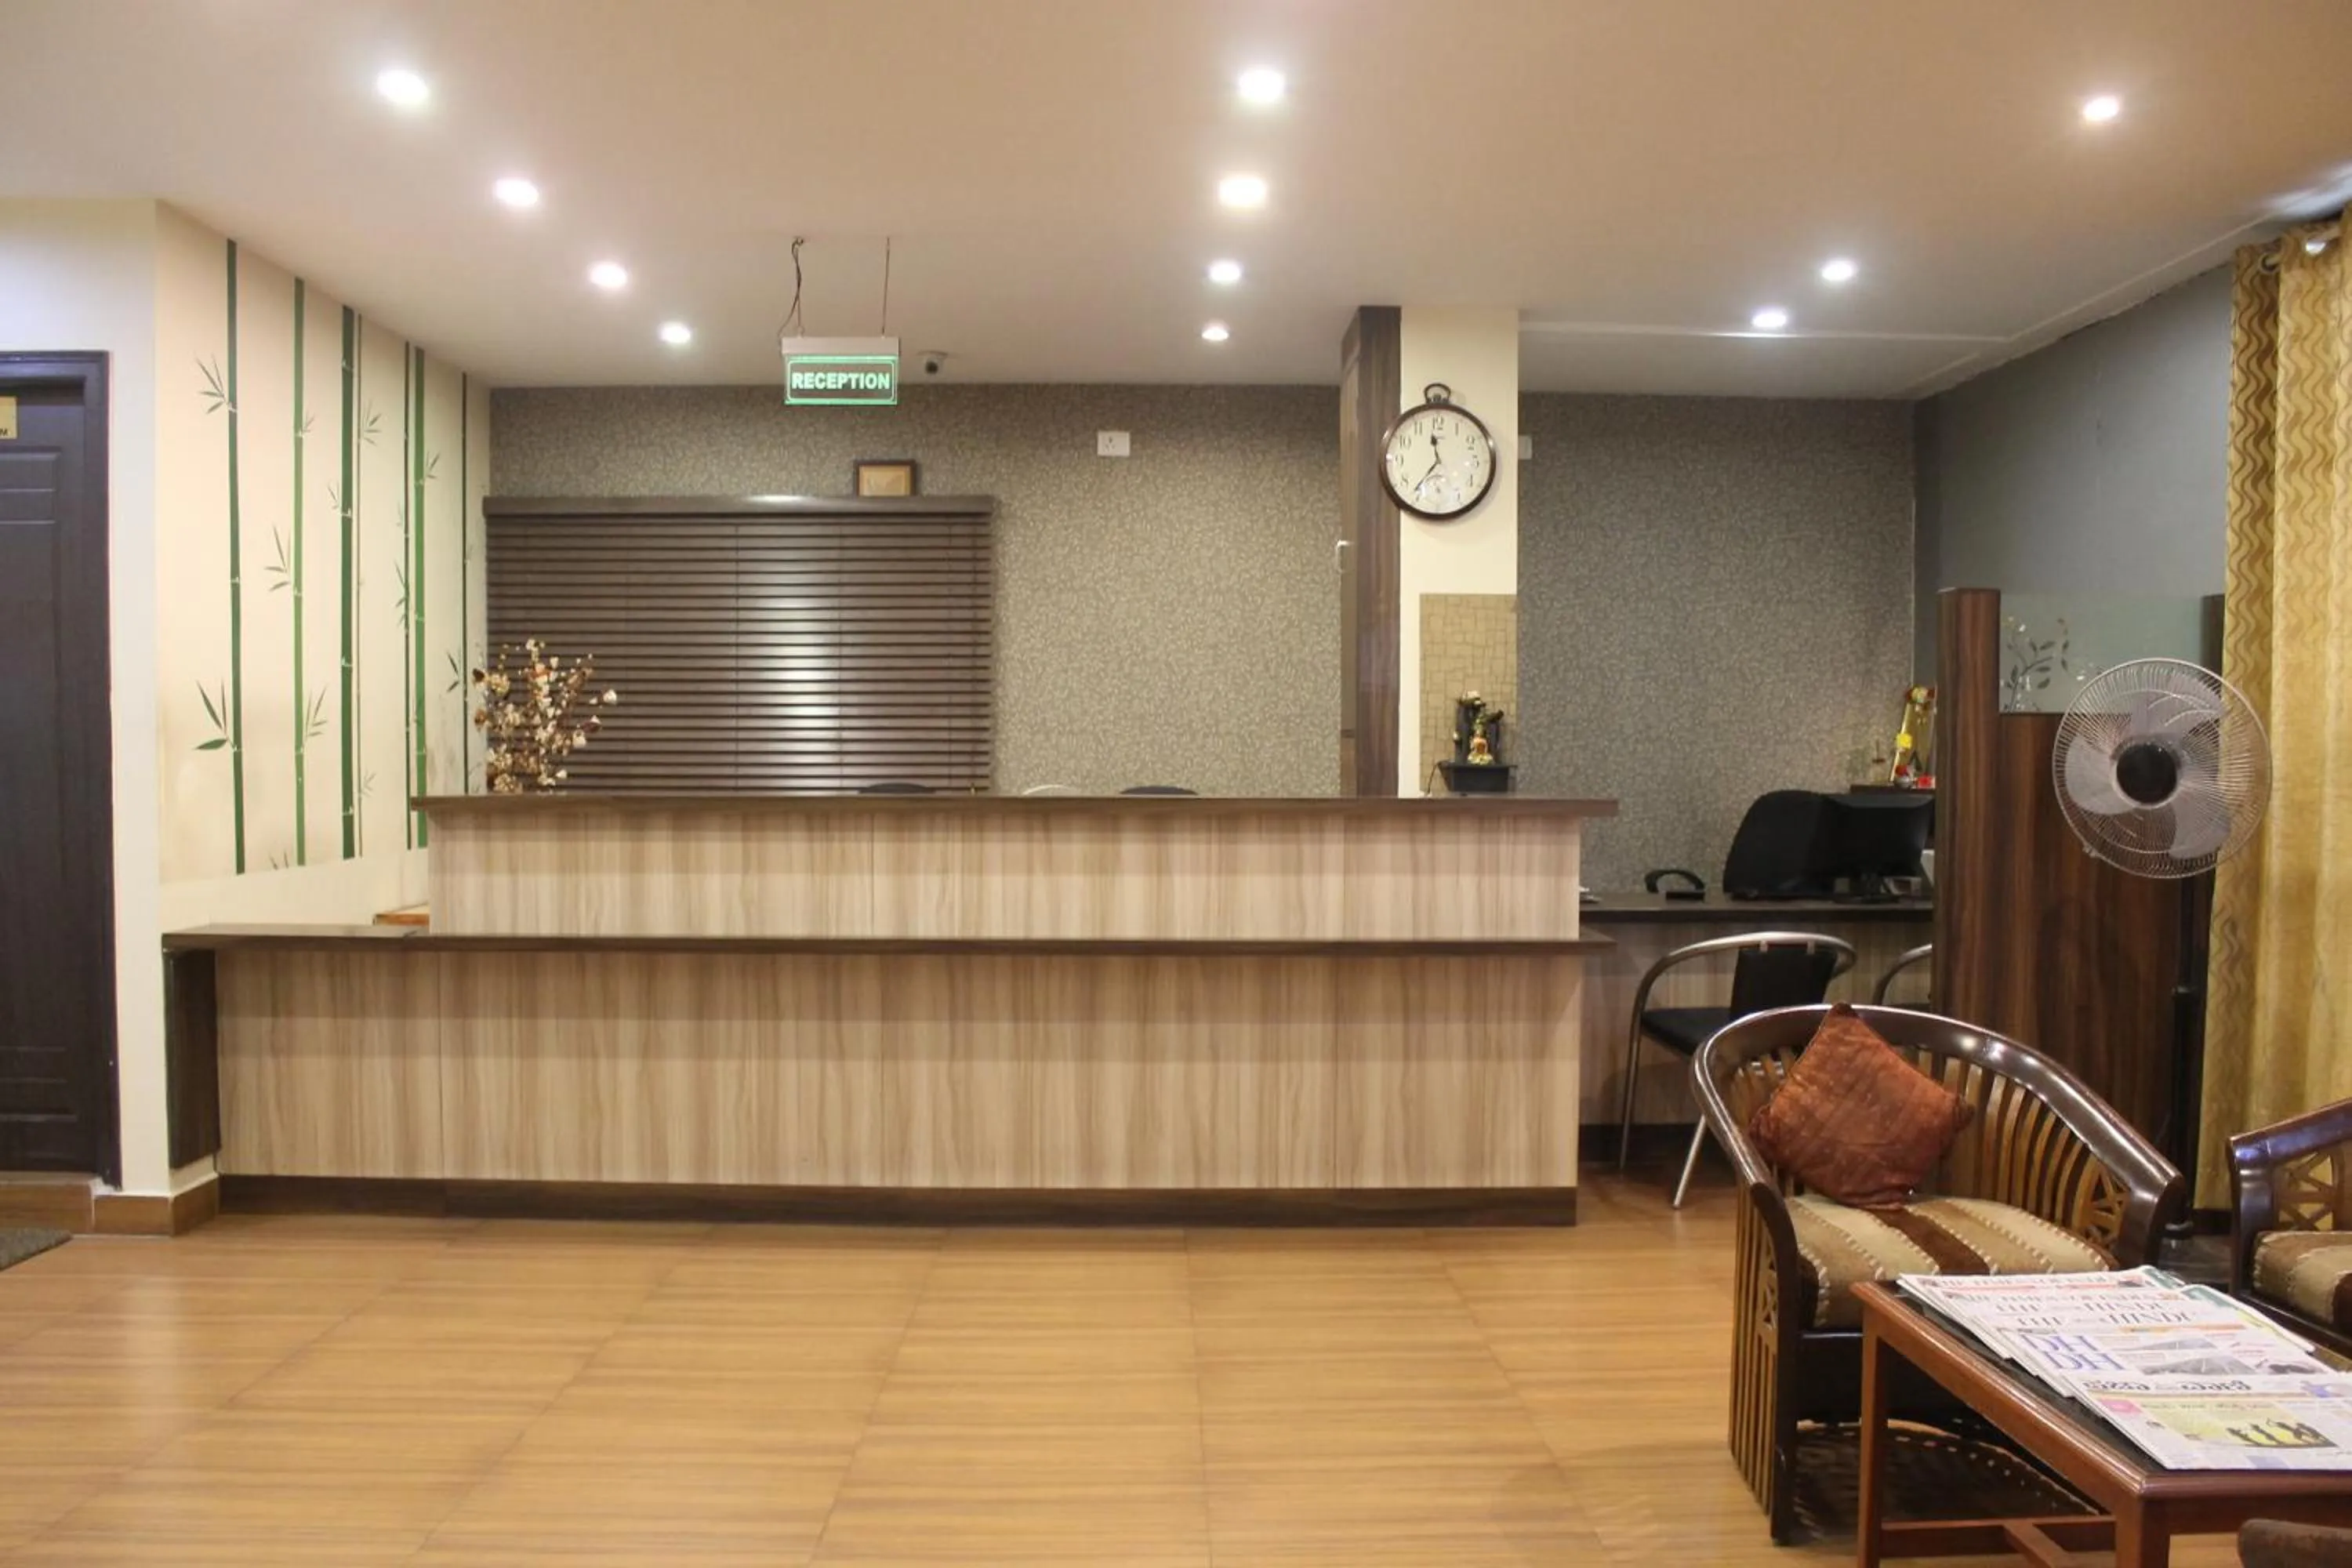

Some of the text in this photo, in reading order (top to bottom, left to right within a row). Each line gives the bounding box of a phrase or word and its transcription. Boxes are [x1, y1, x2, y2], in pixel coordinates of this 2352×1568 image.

[791, 372, 891, 390] RECEPTION
[1414, 421, 1423, 435] 11
[1432, 416, 1444, 430] 12
[1454, 423, 1459, 436] 1
[1399, 435, 1412, 449] 10
[1465, 435, 1475, 451] 2
[2020, 1334, 2100, 1352] DH
[2042, 1351, 2126, 1370] DH
